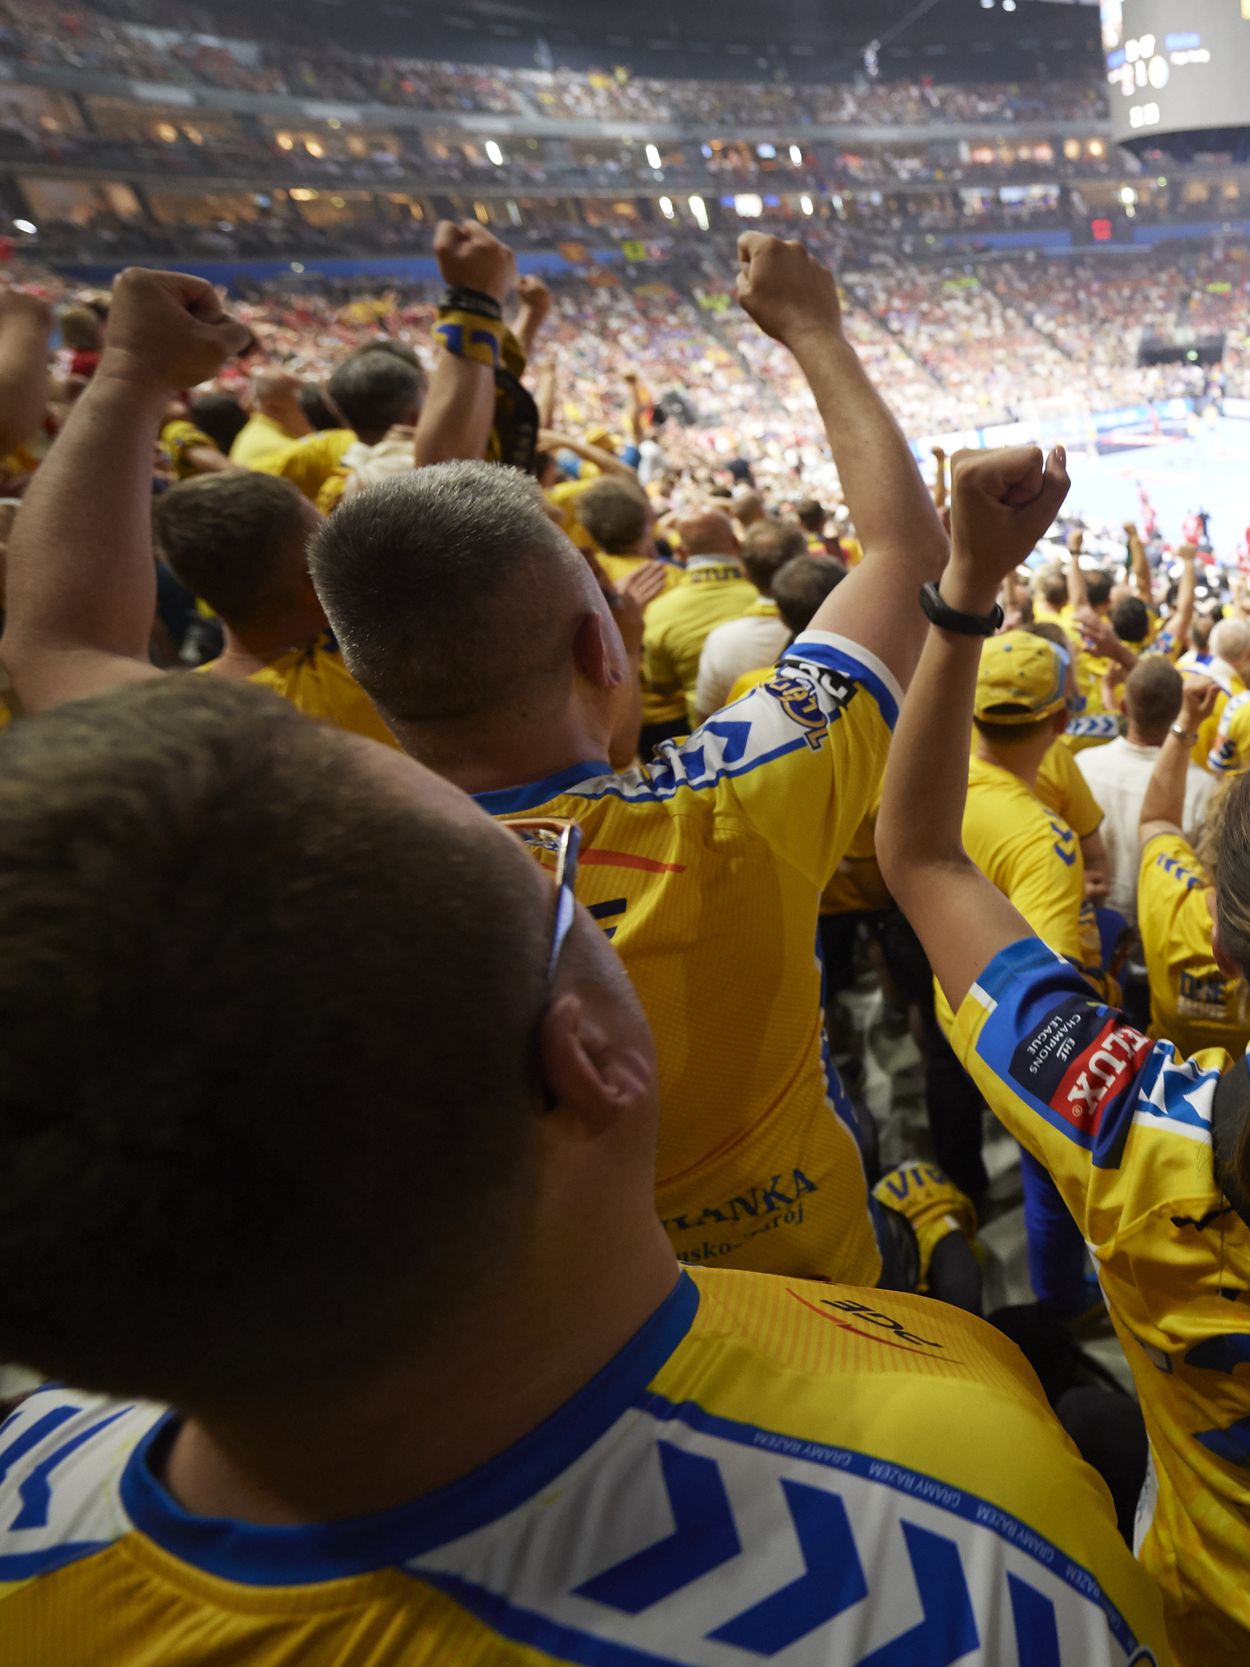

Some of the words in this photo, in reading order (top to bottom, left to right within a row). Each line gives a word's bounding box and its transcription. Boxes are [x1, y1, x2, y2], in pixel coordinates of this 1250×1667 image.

[1026, 1015, 1063, 1055] LEAGUE
[1029, 1013, 1082, 1075] CHAMPIONS
[1056, 1037, 1077, 1063] EHF
[819, 1299, 944, 1349] PGE
[753, 1431, 803, 1456] RAZEM
[804, 1444, 853, 1468] GRAMY
[868, 1460, 916, 1489] RAZEM
[914, 1482, 962, 1508] GRAMY
[975, 1502, 1018, 1538] RAZEM
